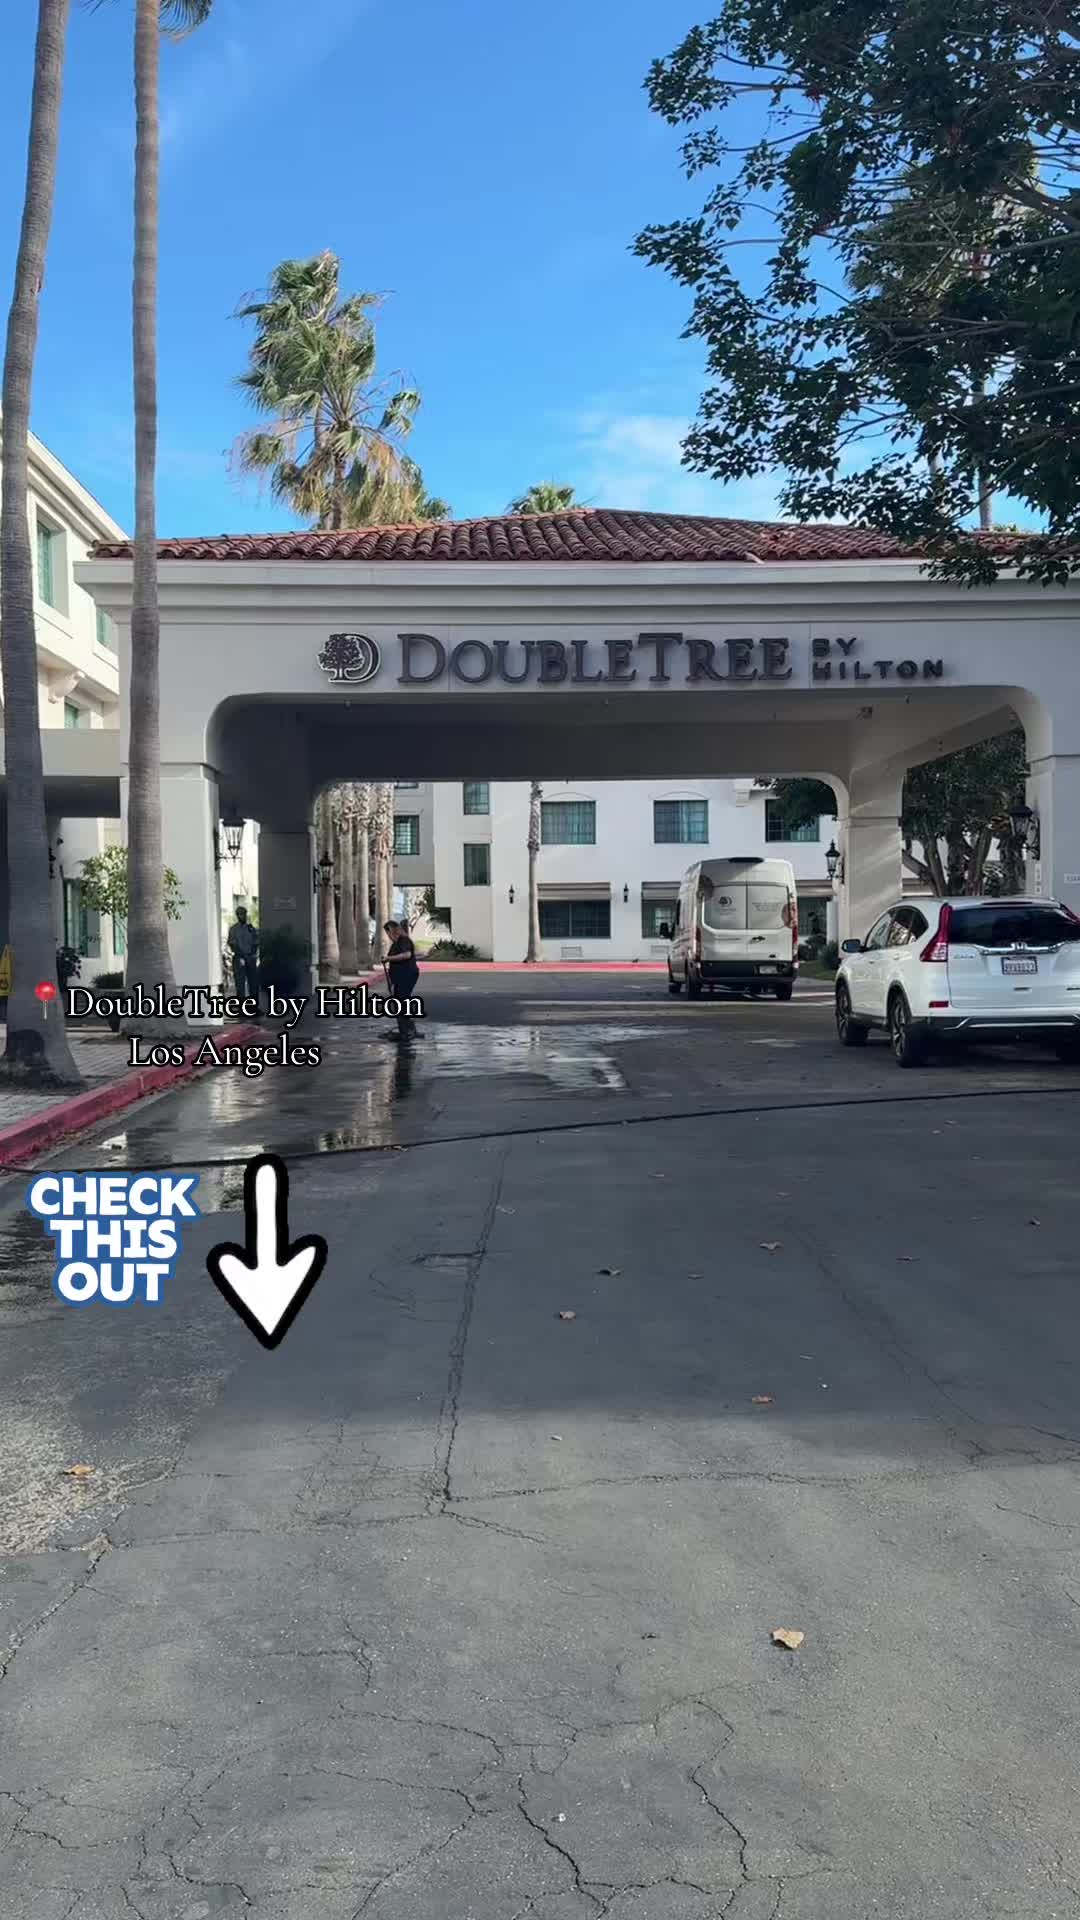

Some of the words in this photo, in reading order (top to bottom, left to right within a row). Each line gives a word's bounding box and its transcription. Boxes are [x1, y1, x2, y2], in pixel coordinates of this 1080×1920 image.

[397, 632, 793, 684] DOUBLETREE
[812, 637, 857, 657] BY
[812, 659, 944, 681] HILTON
